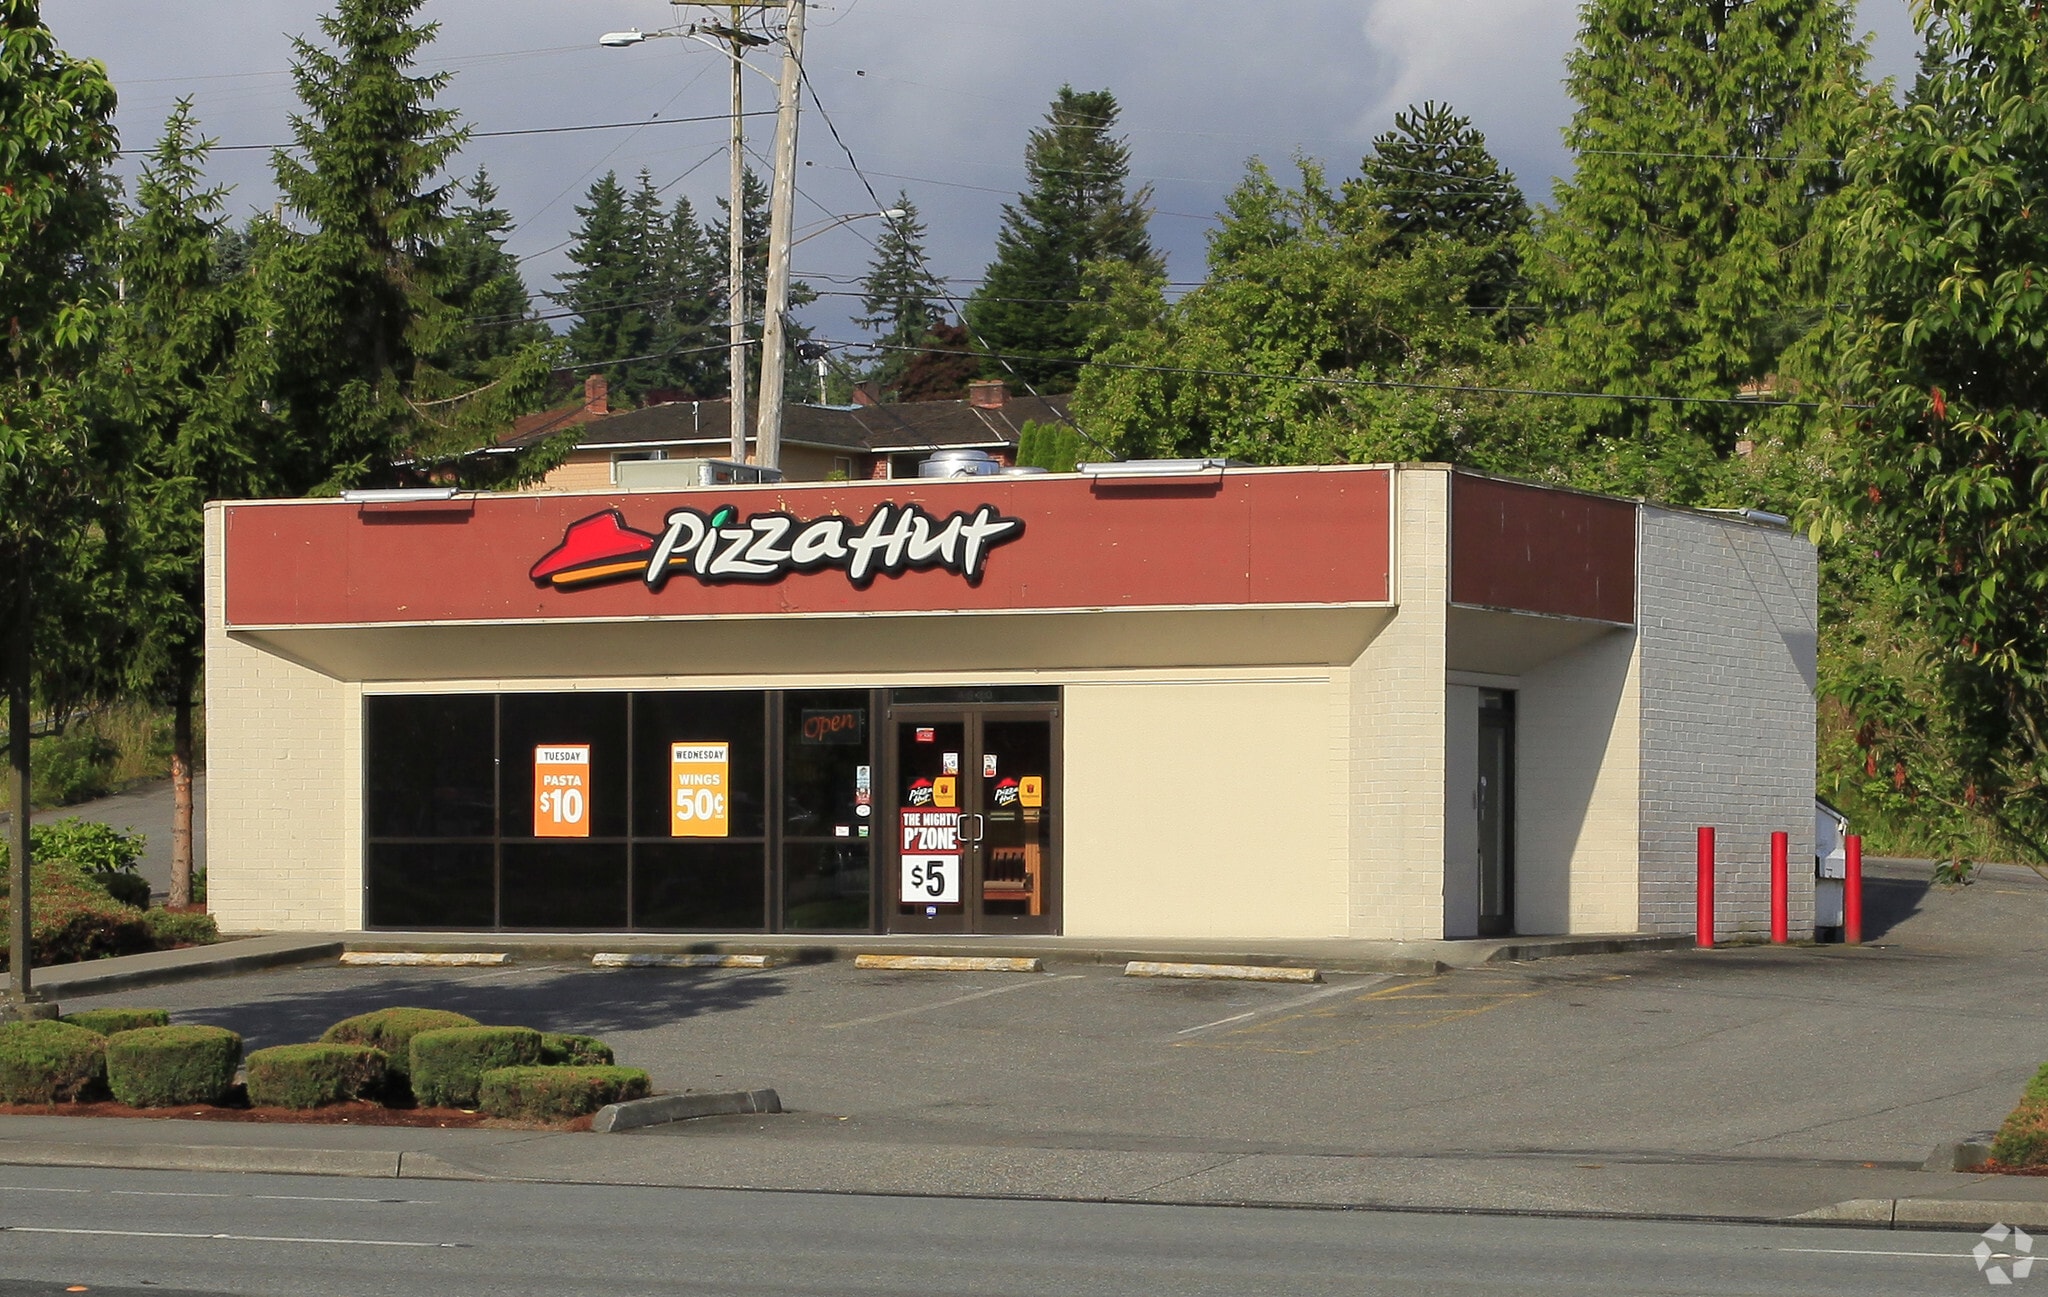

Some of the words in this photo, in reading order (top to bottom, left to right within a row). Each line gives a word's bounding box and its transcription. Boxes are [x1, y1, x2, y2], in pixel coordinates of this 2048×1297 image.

[647, 509, 847, 582] Pizza
[848, 507, 1016, 579] Hut
[804, 714, 856, 742] Open
[544, 752, 581, 761] TUESDAY
[676, 750, 724, 760] WEDNESDAY
[543, 775, 582, 786] PASTA
[679, 774, 720, 786] WINGS
[540, 788, 583, 824] $10
[676, 788, 724, 821] 50¢
[903, 813, 921, 826] THE
[923, 813, 958, 826] MIGHTY
[904, 827, 957, 850] P'ZONE
[911, 860, 945, 897] $5
